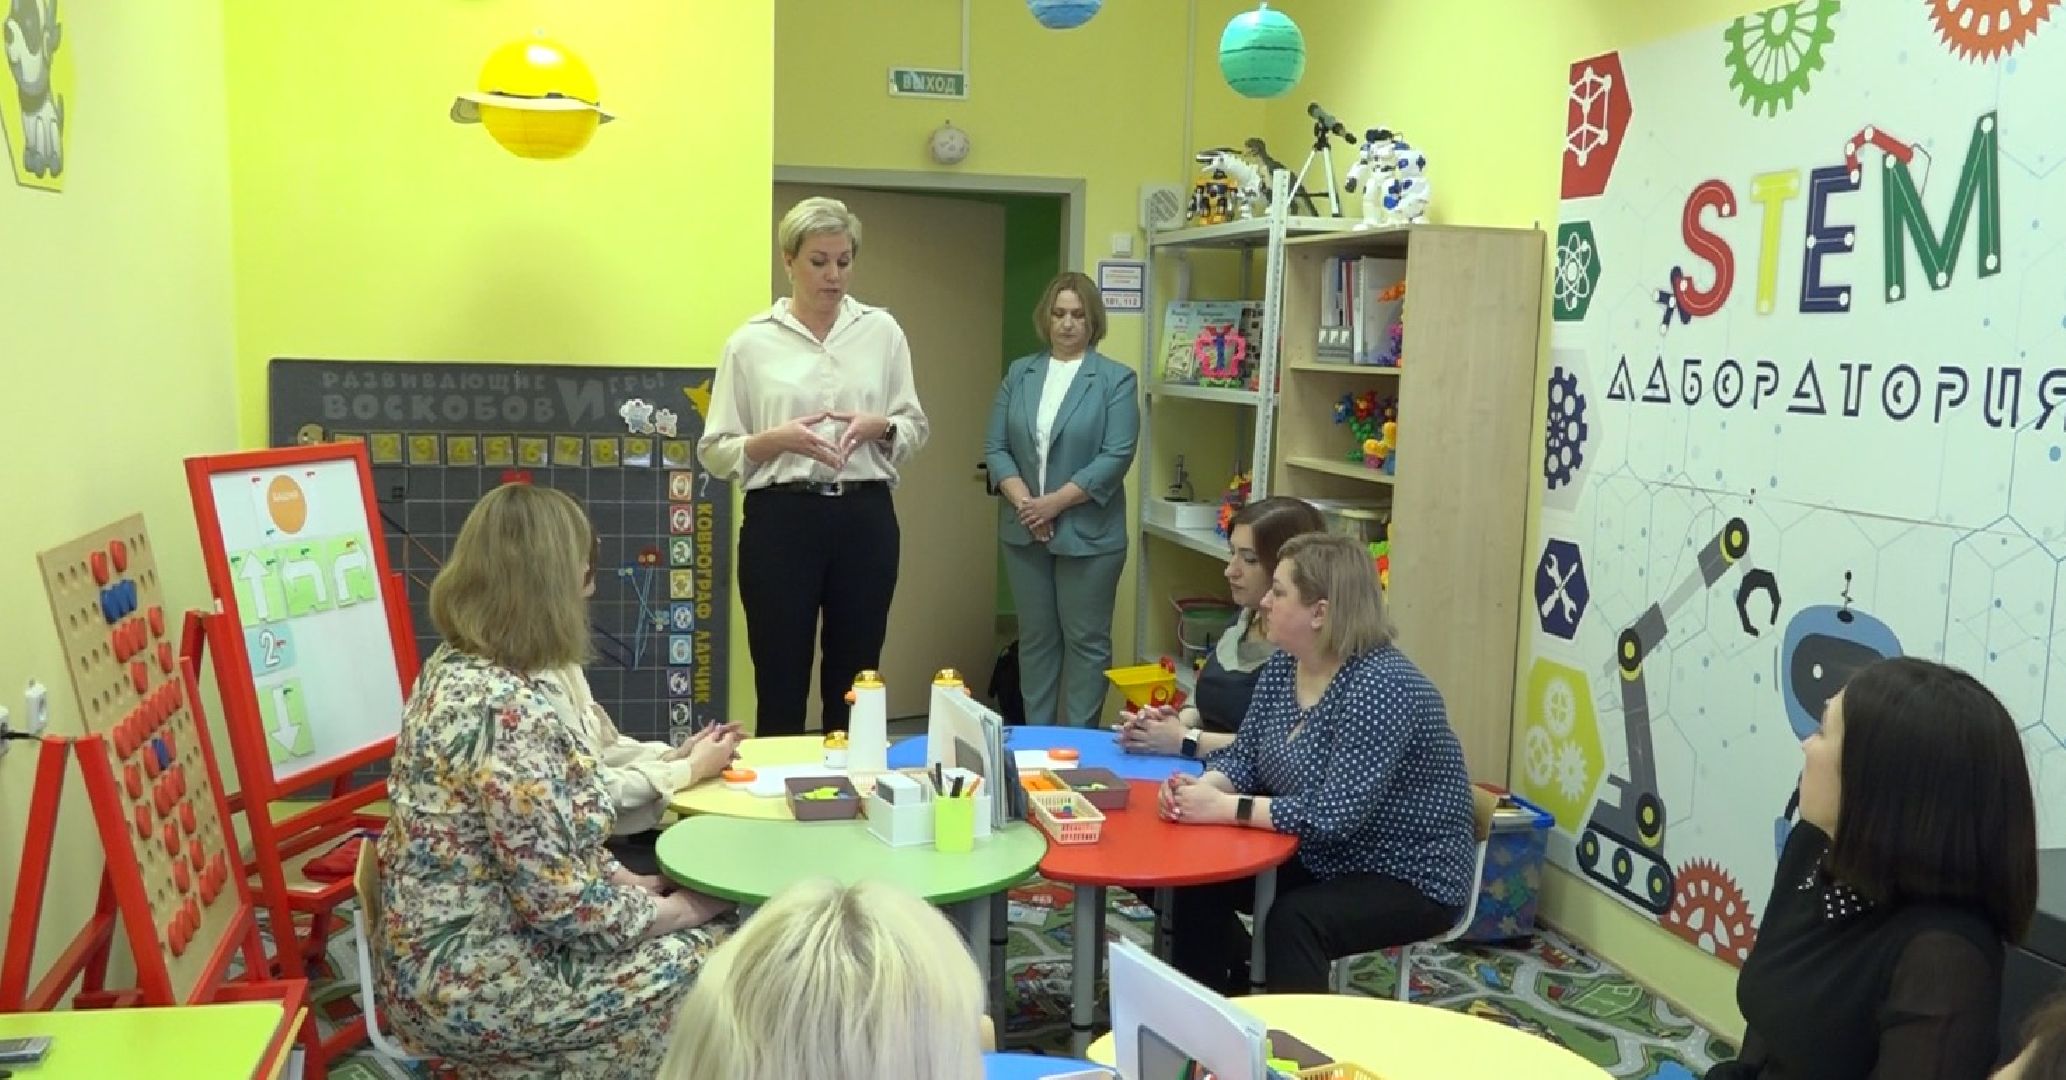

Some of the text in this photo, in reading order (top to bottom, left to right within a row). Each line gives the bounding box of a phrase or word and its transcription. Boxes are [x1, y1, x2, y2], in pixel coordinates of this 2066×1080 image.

[902, 73, 956, 95] ВЫХОД
[1673, 109, 2001, 318] STEM
[322, 371, 545, 394] РАЗВИВАЮЩИЕ
[1605, 353, 2066, 431] ЛАБОРАТОРИЯ
[694, 503, 712, 704] КОВРОГРАФ ЛАРЧИК
[259, 628, 281, 667] 2
